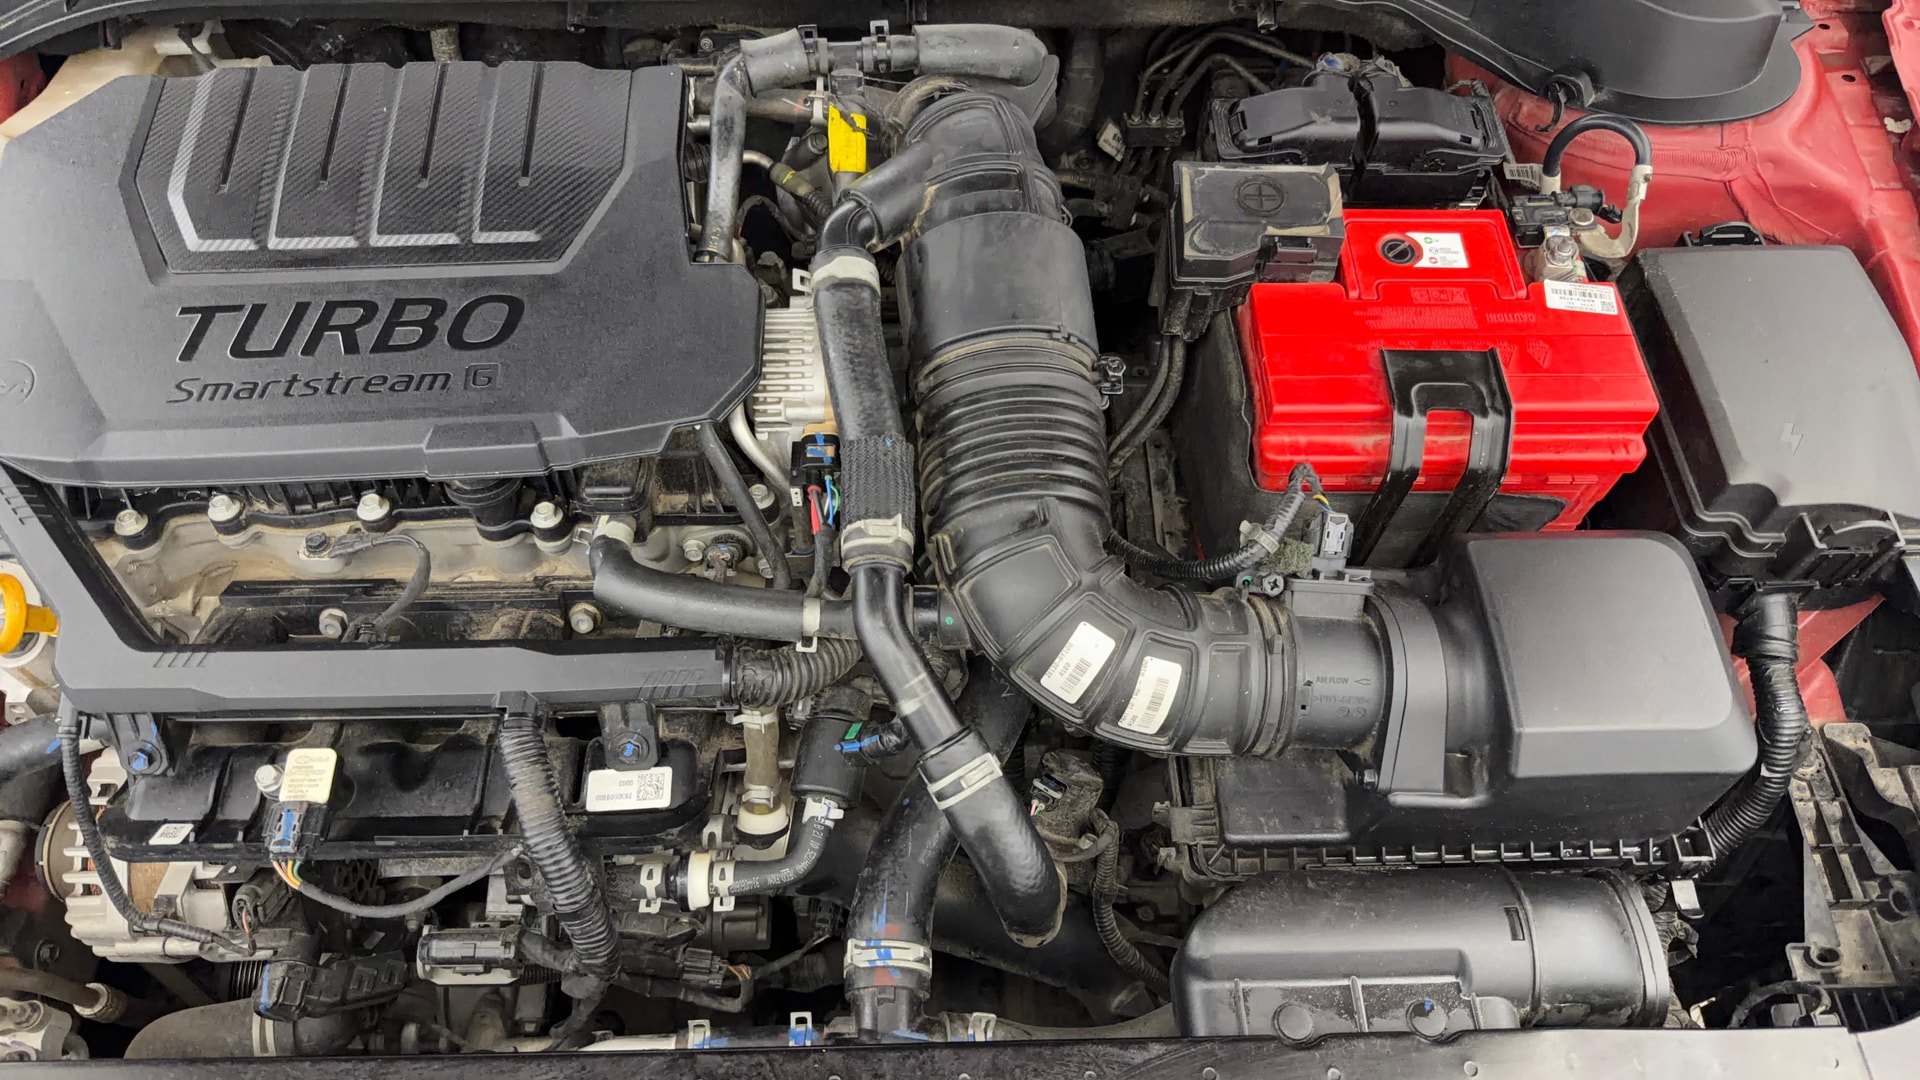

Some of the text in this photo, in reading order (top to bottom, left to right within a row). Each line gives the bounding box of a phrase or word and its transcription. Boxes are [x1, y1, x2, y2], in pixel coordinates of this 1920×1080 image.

[176, 294, 525, 363] TURBO
[166, 366, 496, 404] Smartstream G
[1316, 676, 1350, 685] AIR FLOW
